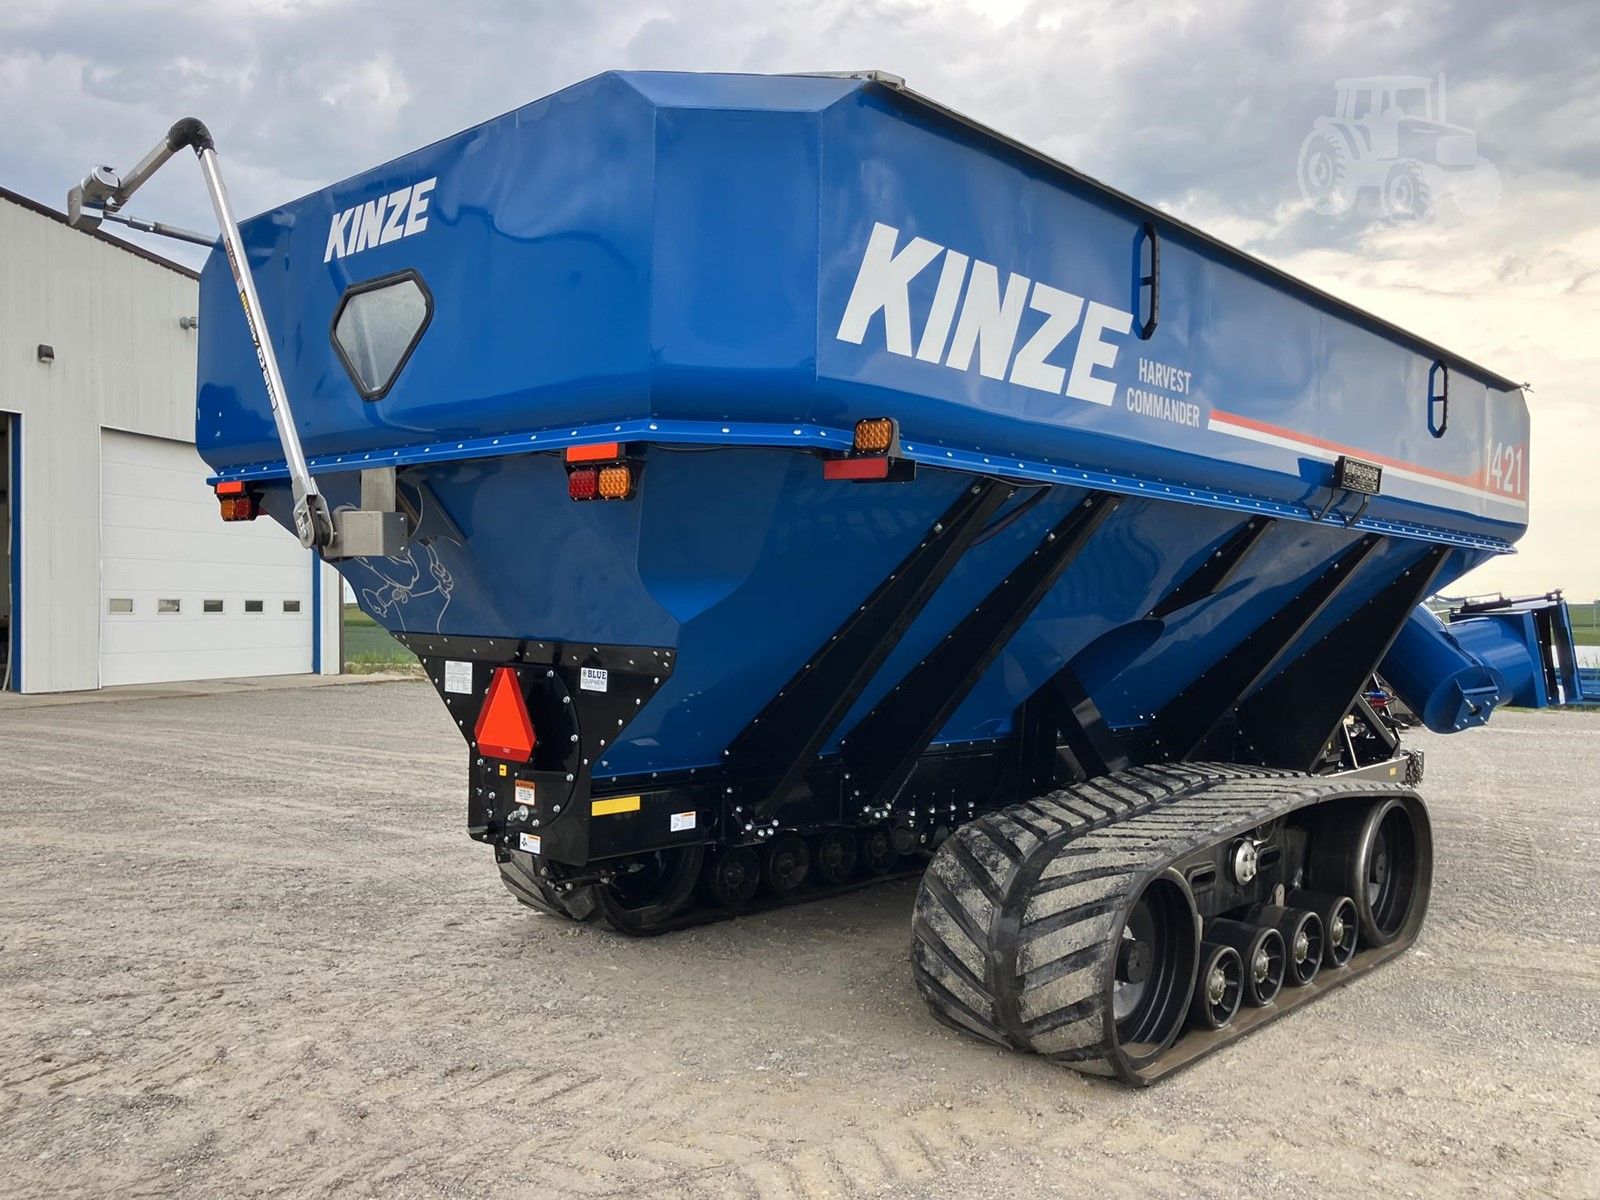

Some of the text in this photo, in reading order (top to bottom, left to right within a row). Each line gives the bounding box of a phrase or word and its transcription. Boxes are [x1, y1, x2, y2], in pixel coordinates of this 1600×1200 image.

[323, 176, 437, 263] KINZE
[836, 221, 1134, 407] KINZE
[1138, 357, 1191, 394] HARVEST
[1126, 387, 1200, 428] COMMANDER
[1486, 438, 1522, 494] 1421
[587, 669, 607, 680] BLUE
